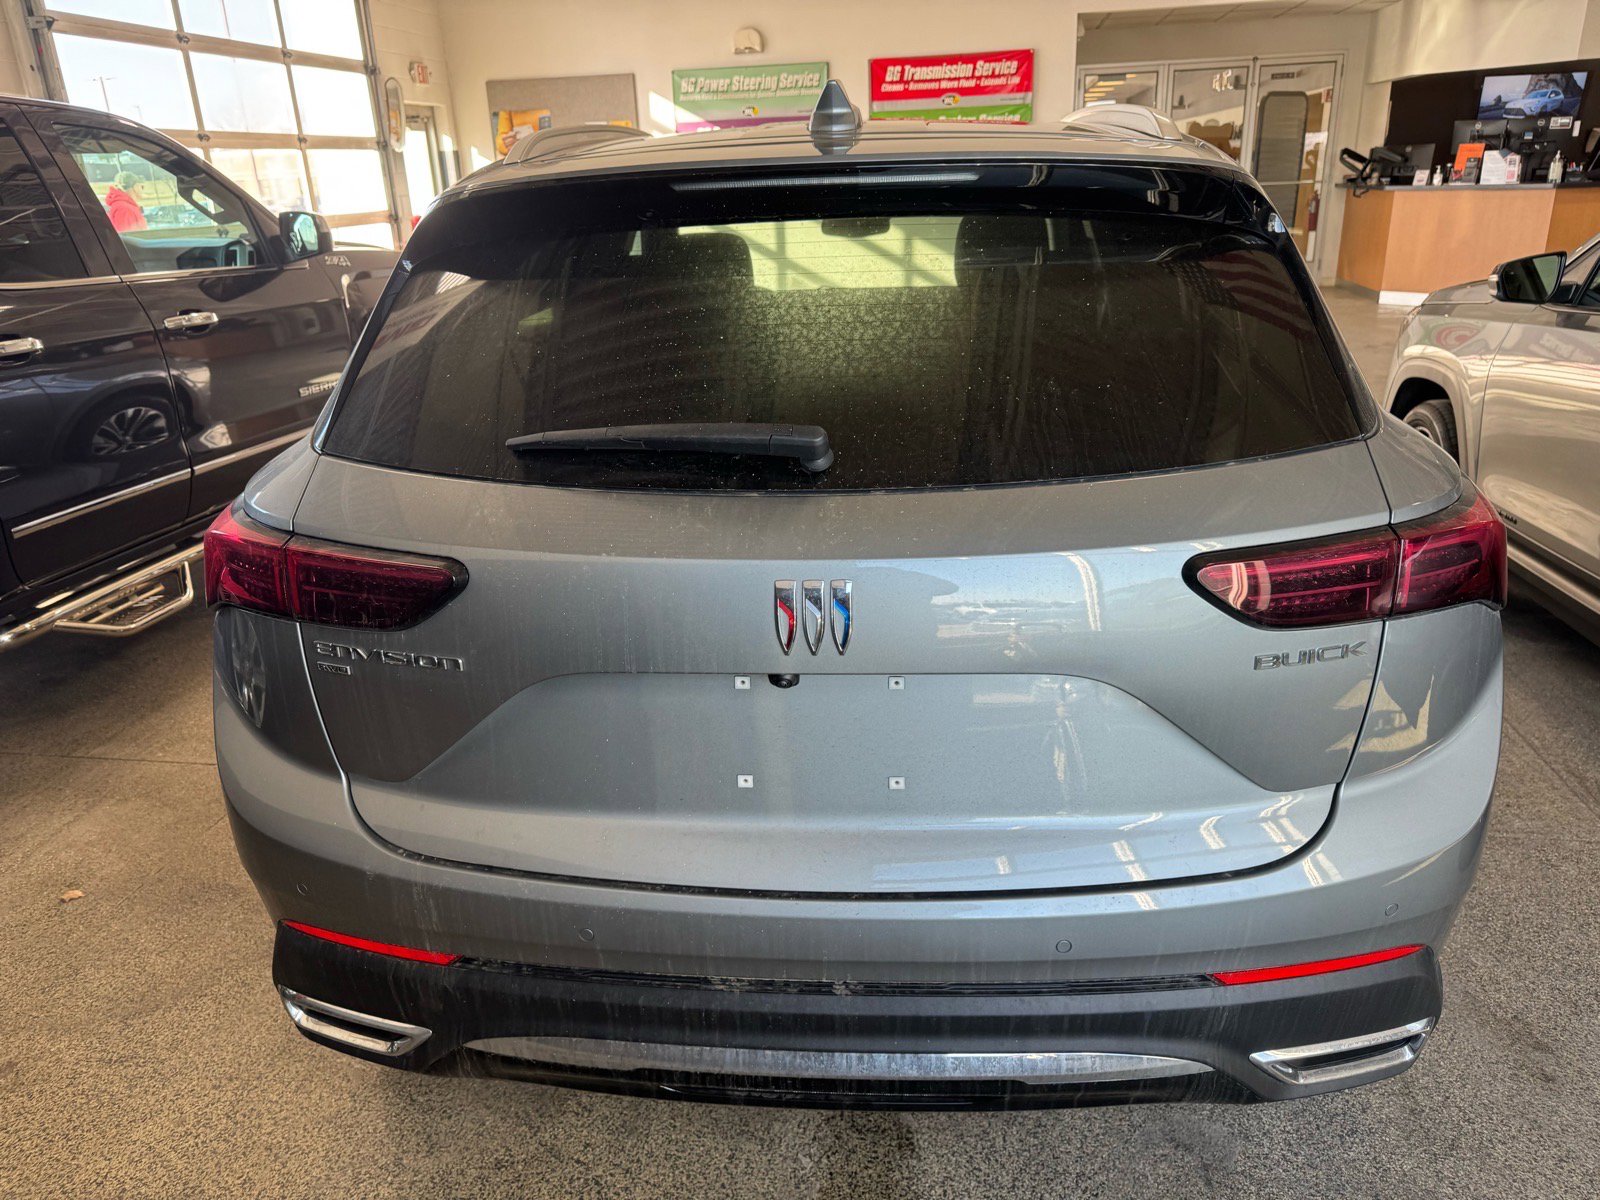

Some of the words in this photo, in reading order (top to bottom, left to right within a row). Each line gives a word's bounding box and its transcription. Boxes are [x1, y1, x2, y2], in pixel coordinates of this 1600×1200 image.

[904, 62, 974, 81] Transmission
[974, 59, 1018, 77] Service
[696, 76, 731, 93] Power
[732, 73, 778, 92] Steering
[779, 71, 821, 89] Service
[298, 380, 339, 398] SIERR
[1253, 640, 1368, 671] BUICK
